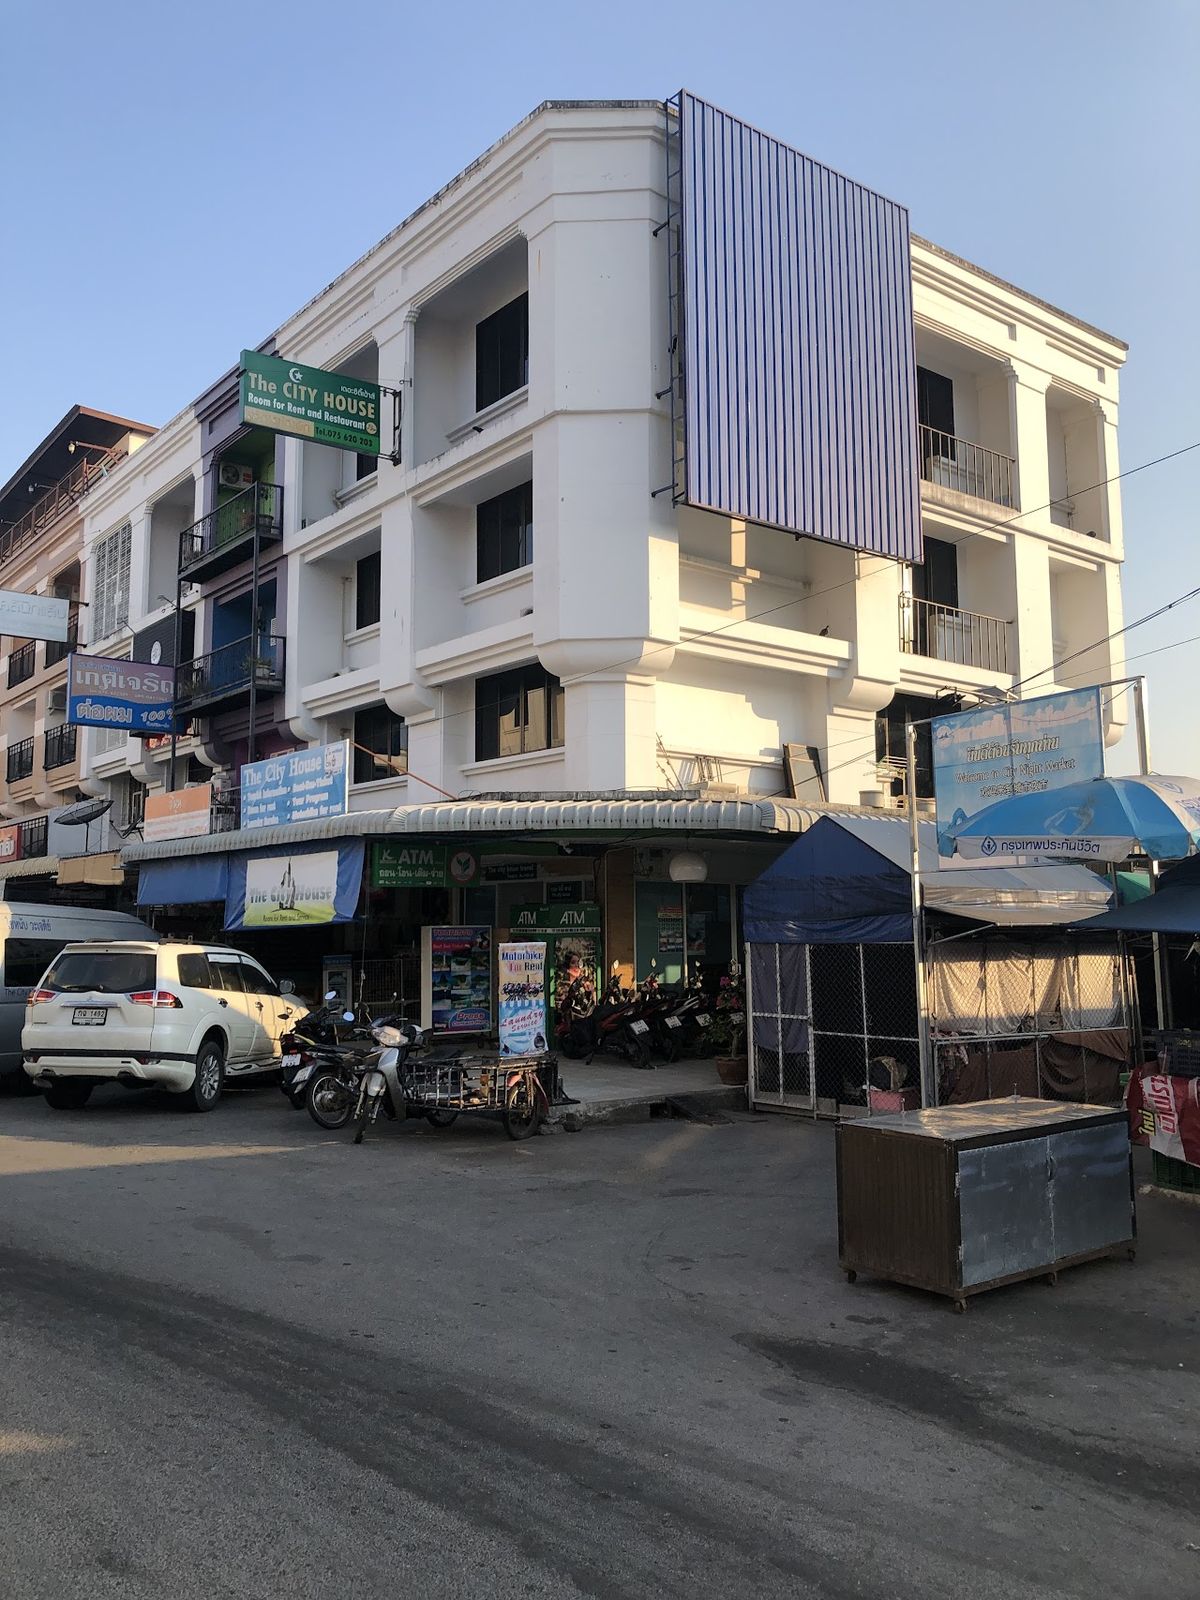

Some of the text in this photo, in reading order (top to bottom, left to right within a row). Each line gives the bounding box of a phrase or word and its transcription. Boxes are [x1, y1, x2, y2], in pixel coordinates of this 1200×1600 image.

[248, 372, 375, 419] The CITY HOUSE
[248, 392, 366, 430] Room for Rent and Restaurant
[343, 434, 357, 444] 620
[359, 437, 373, 447] 203
[76, 698, 133, 723] ต่อผม
[244, 768, 261, 786] The
[263, 763, 286, 787] City
[289, 757, 322, 776] House
[1019, 763, 1042, 778] Night
[1045, 757, 1075, 772] Market
[1001, 838, 1100, 854] กรุงเทพประกันชีวิต
[398, 849, 434, 864] ATM
[250, 887, 267, 903] The
[294, 884, 332, 901] House
[517, 911, 585, 924] ATM ATM
[501, 950, 544, 961] Motorbike
[524, 962, 543, 971] Rent
[500, 1010, 544, 1027] Laundry
[511, 1020, 538, 1032] Service
[1138, 1109, 1155, 1136] ใหม่
